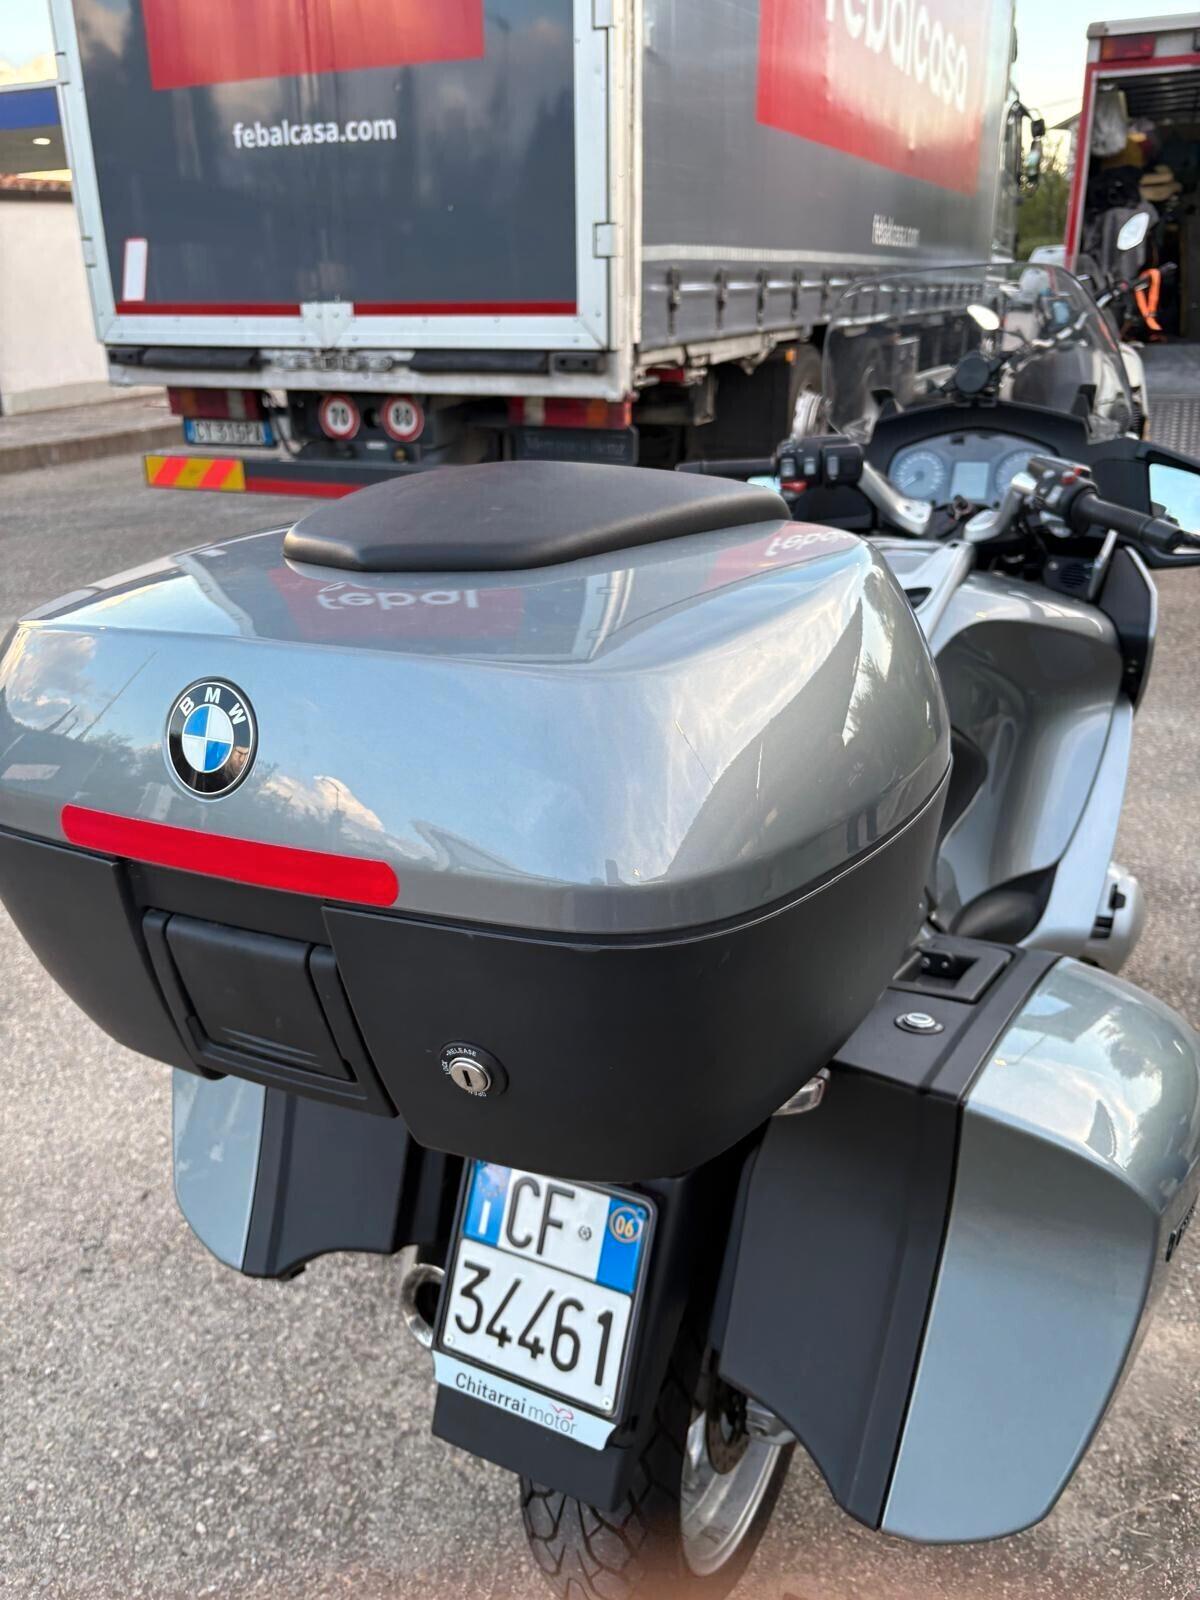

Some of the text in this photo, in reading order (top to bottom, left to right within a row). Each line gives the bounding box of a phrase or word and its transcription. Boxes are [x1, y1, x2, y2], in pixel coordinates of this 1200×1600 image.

[825, 0, 968, 113] alcasa
[233, 118, 397, 149] febalcasa.com
[179, 686, 247, 725] BMW
[446, 1047, 477, 1057] RELEASE
[506, 1175, 576, 1256] CF
[615, 1215, 635, 1237] 06
[454, 1260, 614, 1387] 34461
[454, 1372, 578, 1436] Chitarrai motor
